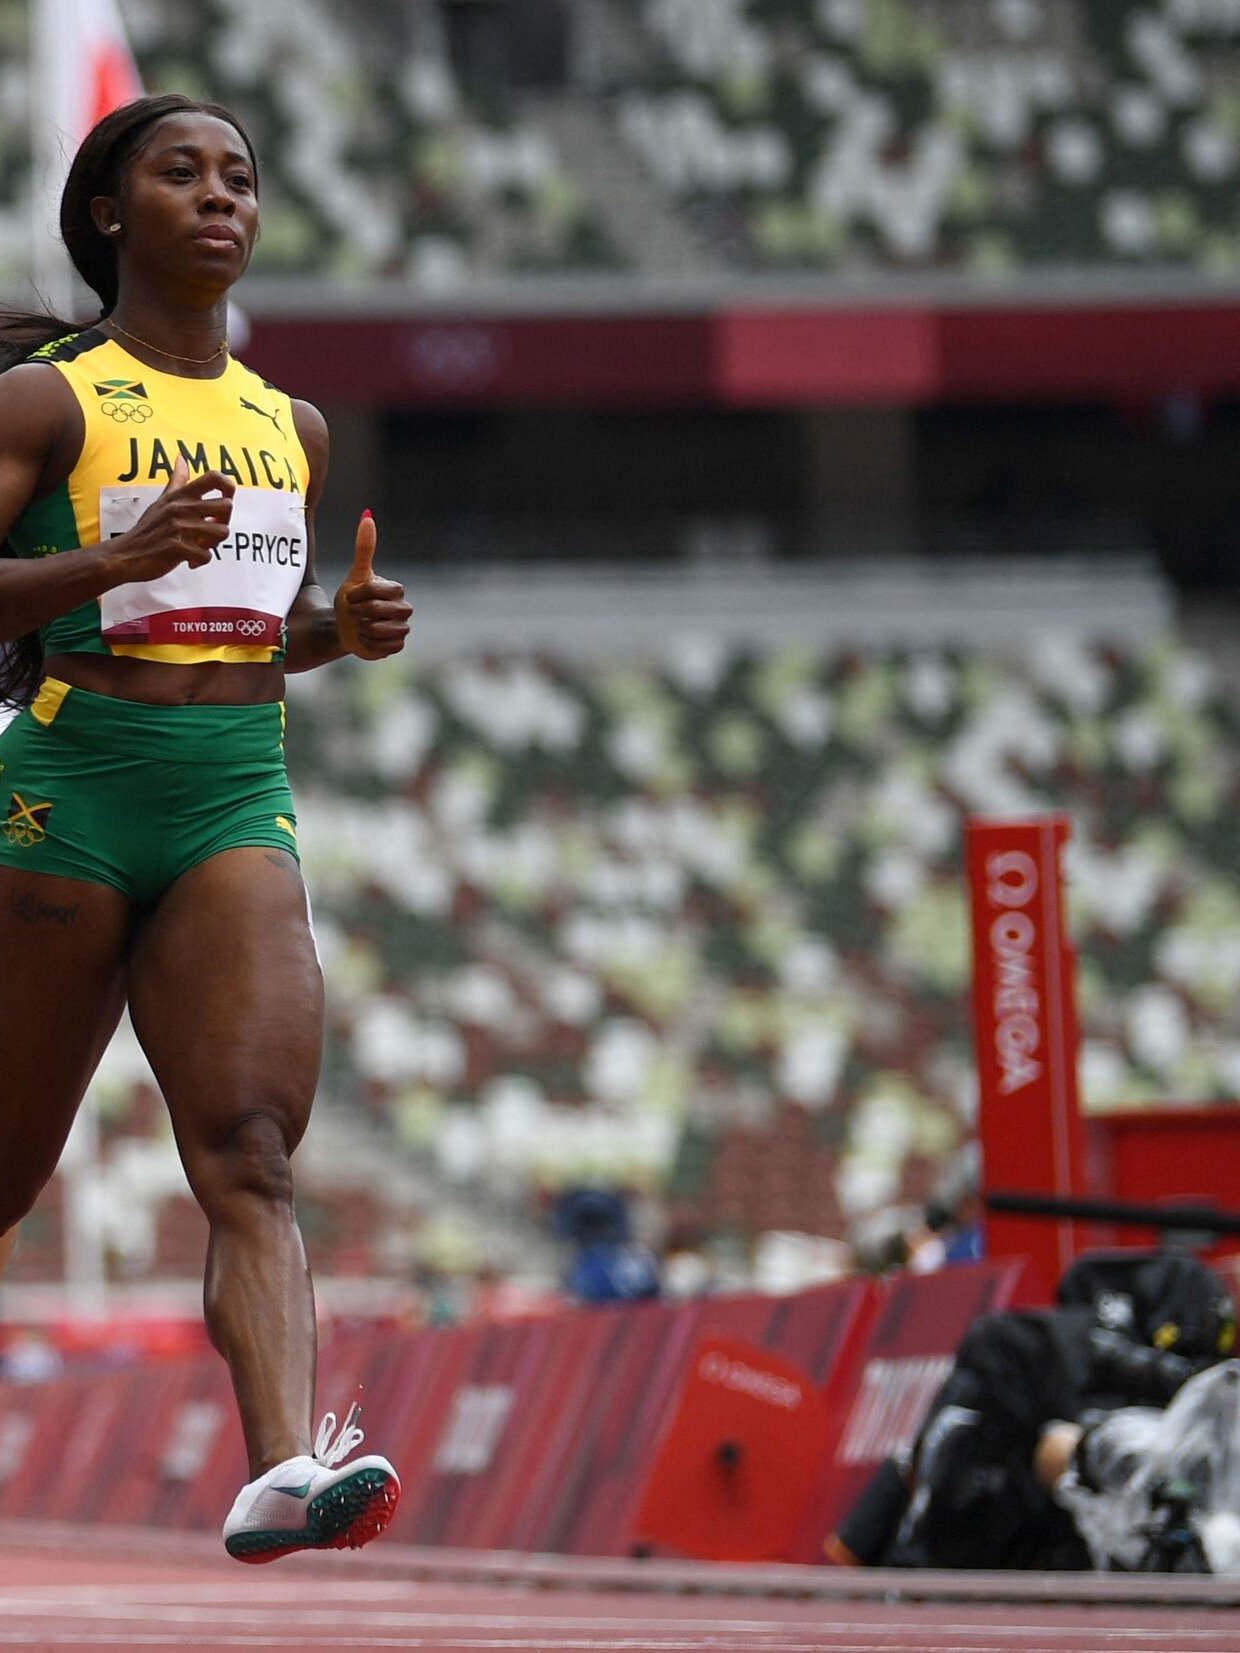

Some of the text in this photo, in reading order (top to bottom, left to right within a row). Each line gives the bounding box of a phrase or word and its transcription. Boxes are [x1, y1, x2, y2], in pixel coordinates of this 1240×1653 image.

[117, 437, 301, 494] JAMAICA
[172, 621, 234, 633] TOKYO 2020
[989, 910, 1043, 1097] OMEGA
